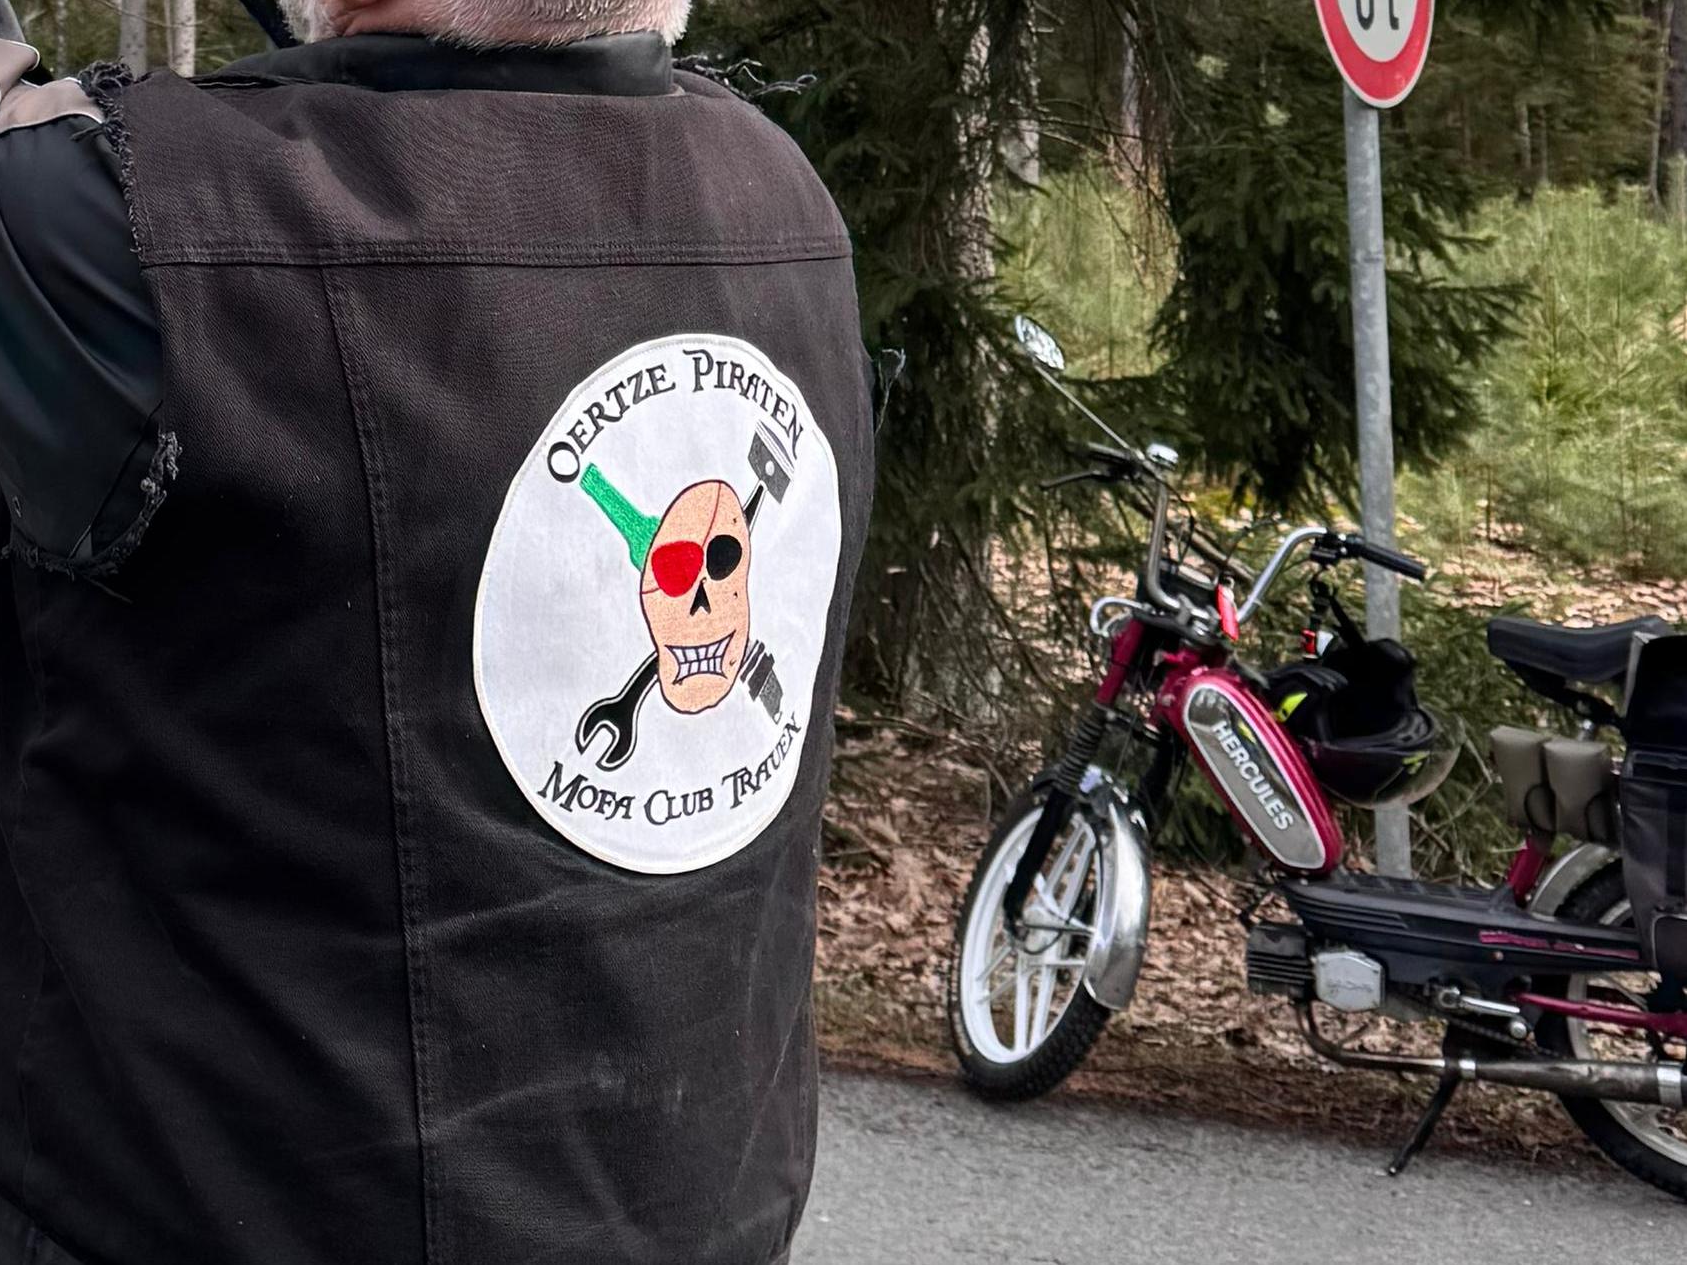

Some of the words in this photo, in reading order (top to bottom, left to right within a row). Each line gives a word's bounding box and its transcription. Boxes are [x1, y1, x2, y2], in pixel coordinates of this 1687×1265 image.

[547, 363, 676, 483] OERTZE
[683, 349, 804, 460] PIRATEN
[537, 760, 636, 820] MOFA
[644, 787, 714, 825] CLUB
[721, 712, 802, 810] TRAUEN
[1212, 720, 1294, 830] HERCULES
